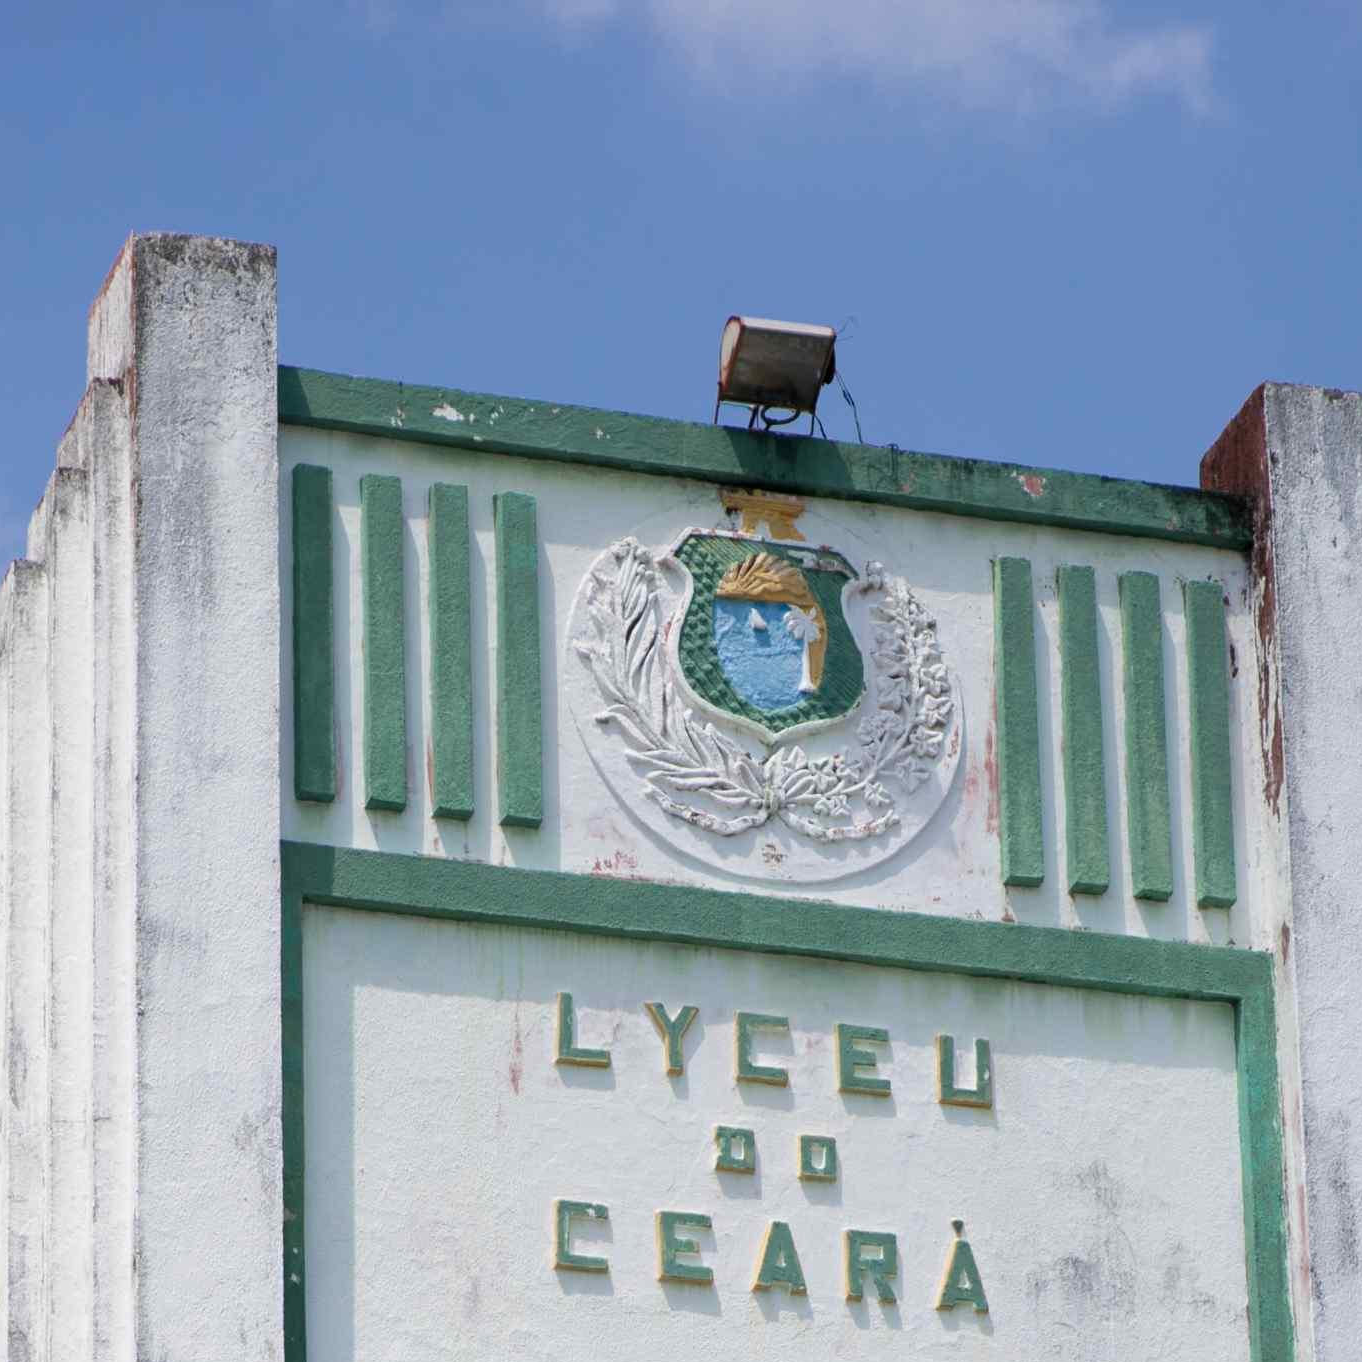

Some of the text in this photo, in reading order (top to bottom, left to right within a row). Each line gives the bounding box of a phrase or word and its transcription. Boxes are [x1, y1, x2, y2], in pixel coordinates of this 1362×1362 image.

[555, 992, 993, 1108] LYCEU
[714, 1125, 837, 1183] DO
[553, 1199, 989, 1314] CEARÁ
